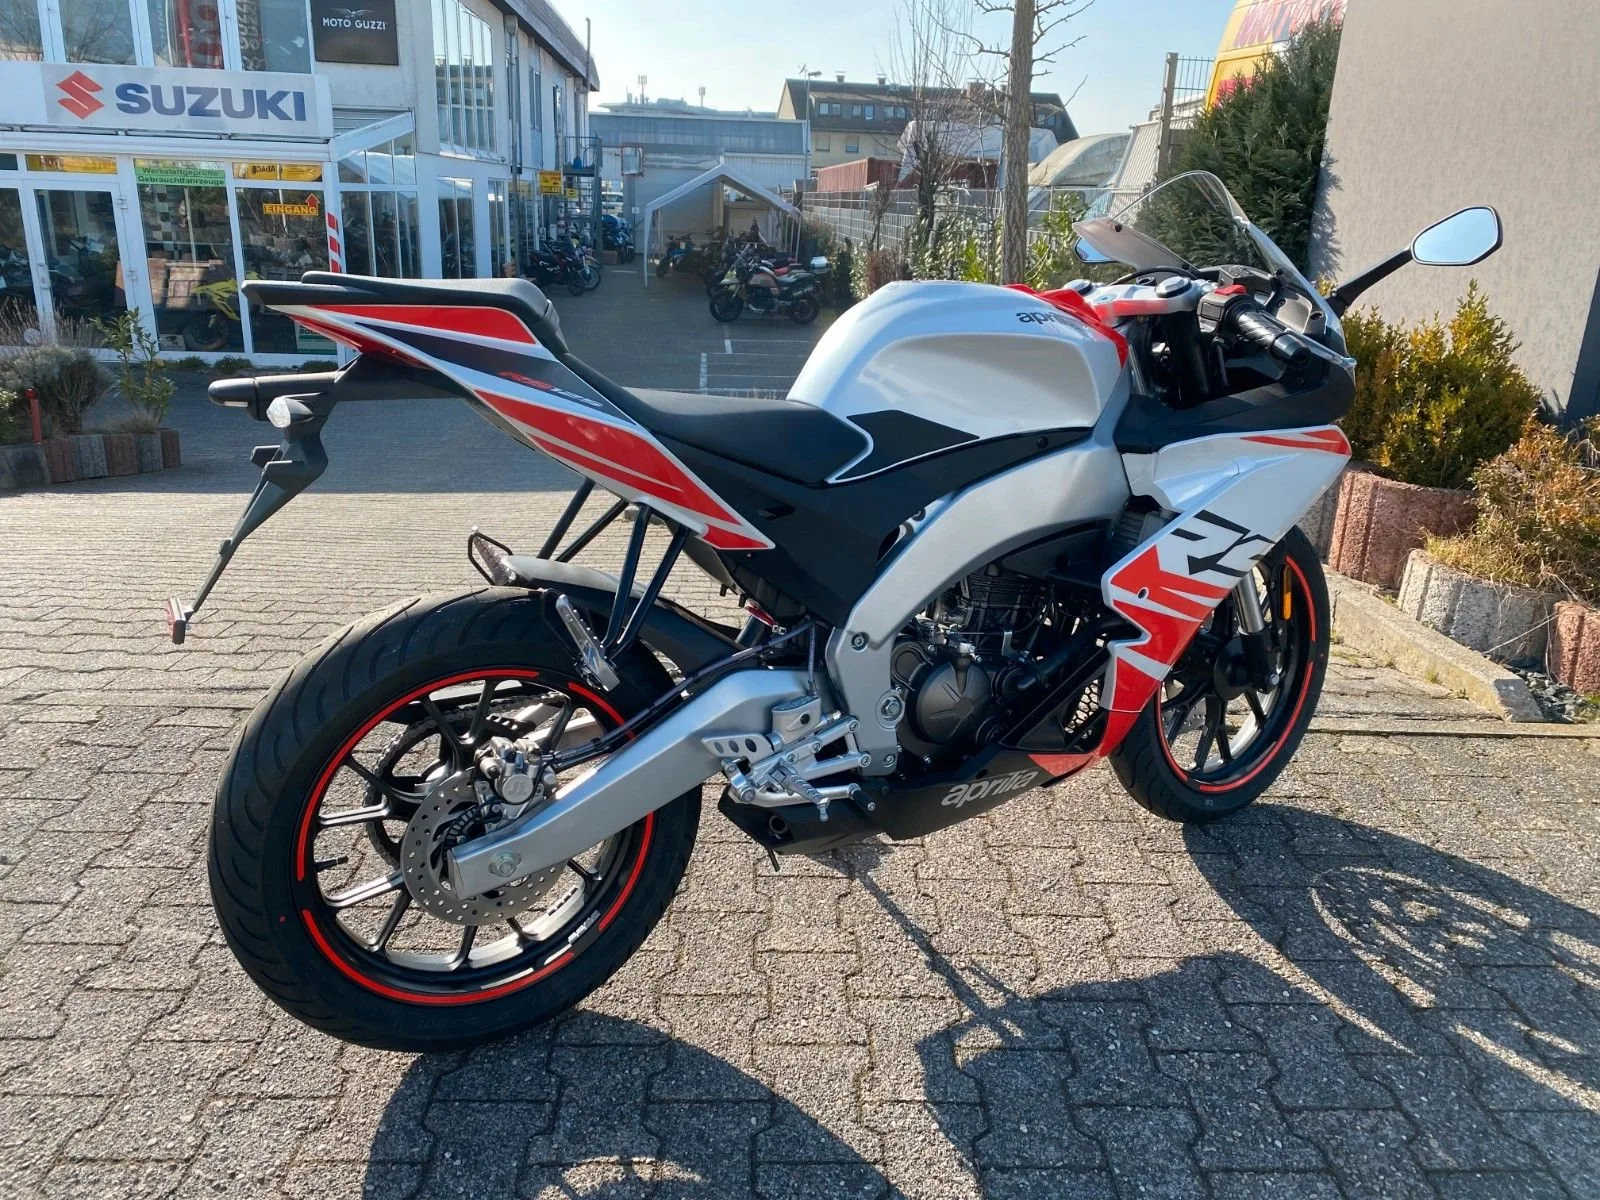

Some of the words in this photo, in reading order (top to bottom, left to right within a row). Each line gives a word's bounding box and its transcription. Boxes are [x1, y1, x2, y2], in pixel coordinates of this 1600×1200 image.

[322, 17, 351, 28] MOTO
[354, 19, 386, 31] GUZZI
[115, 82, 307, 122] SUZUKI
[137, 175, 224, 186] Gebrauchtfahrzeuge
[264, 204, 317, 215] EINGANG
[941, 769, 1039, 808] aprilia
